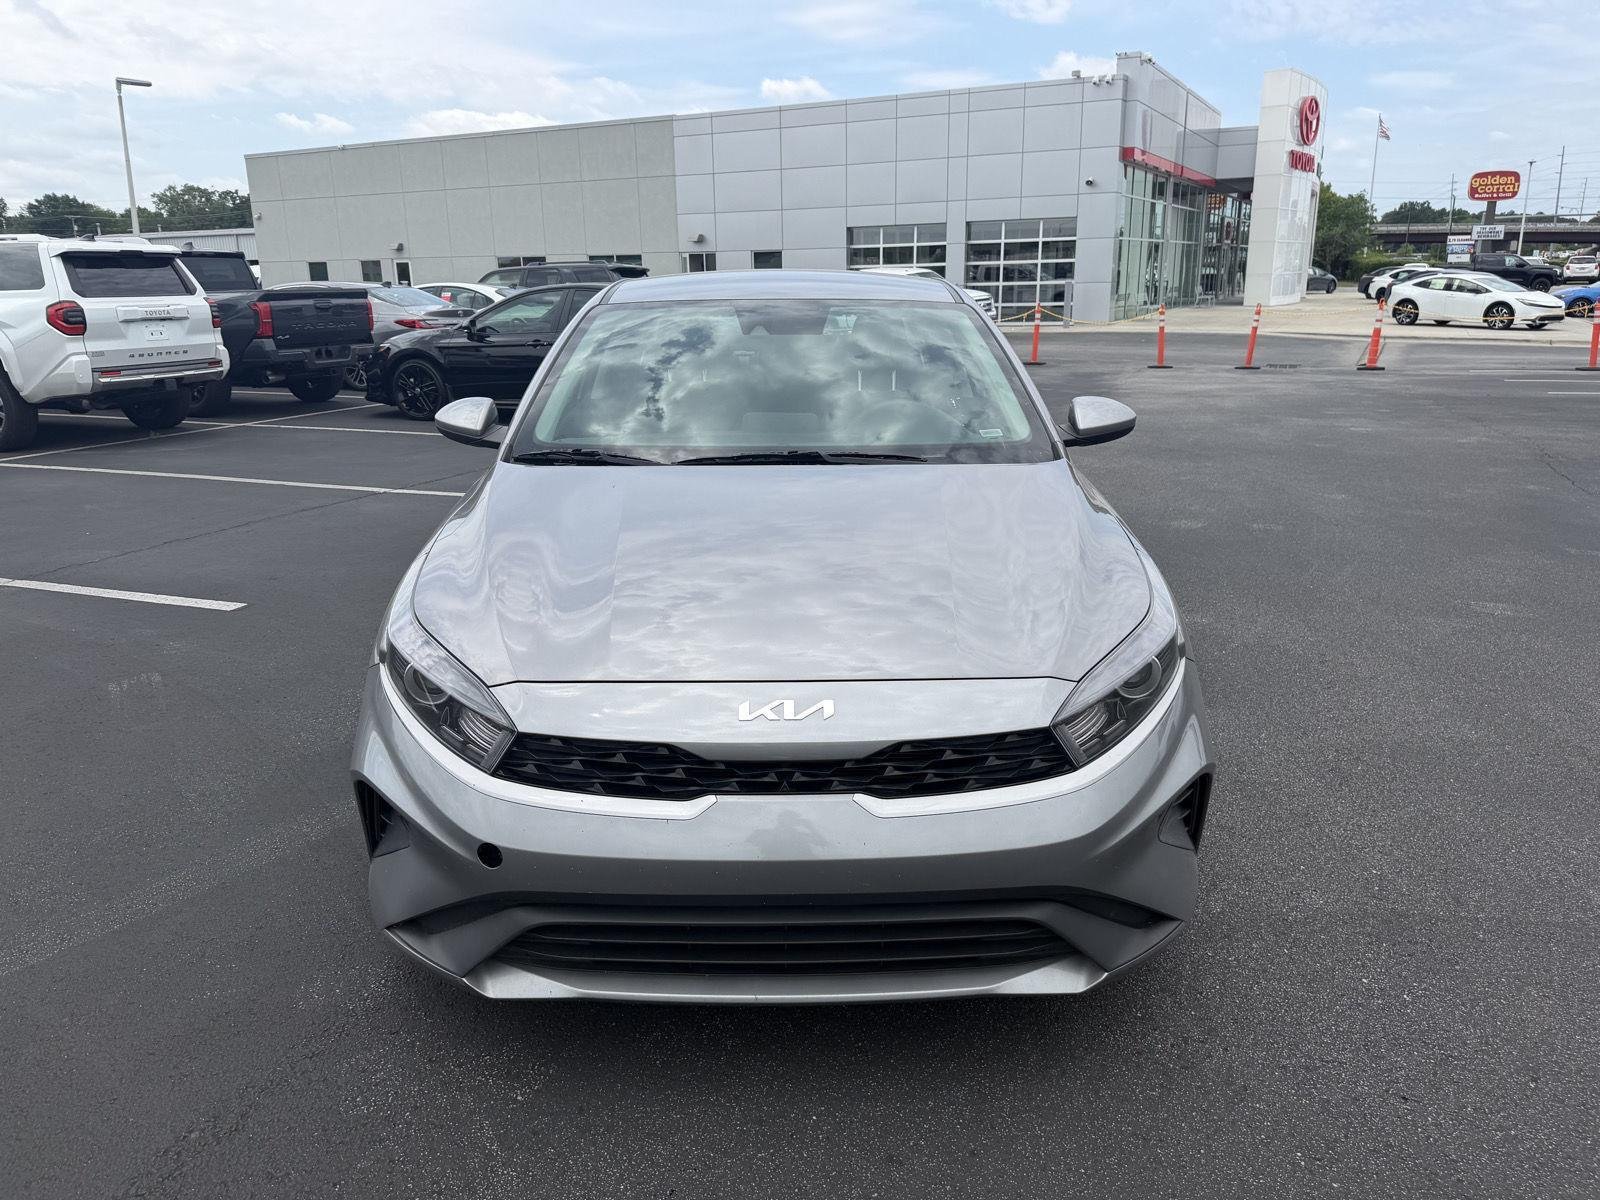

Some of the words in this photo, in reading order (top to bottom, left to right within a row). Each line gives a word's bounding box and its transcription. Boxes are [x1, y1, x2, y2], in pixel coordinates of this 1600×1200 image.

[1471, 175, 1515, 188] golden
[1477, 182, 1519, 193] corral
[128, 349, 189, 358] 4RUNNER
[738, 699, 835, 721] KIA
